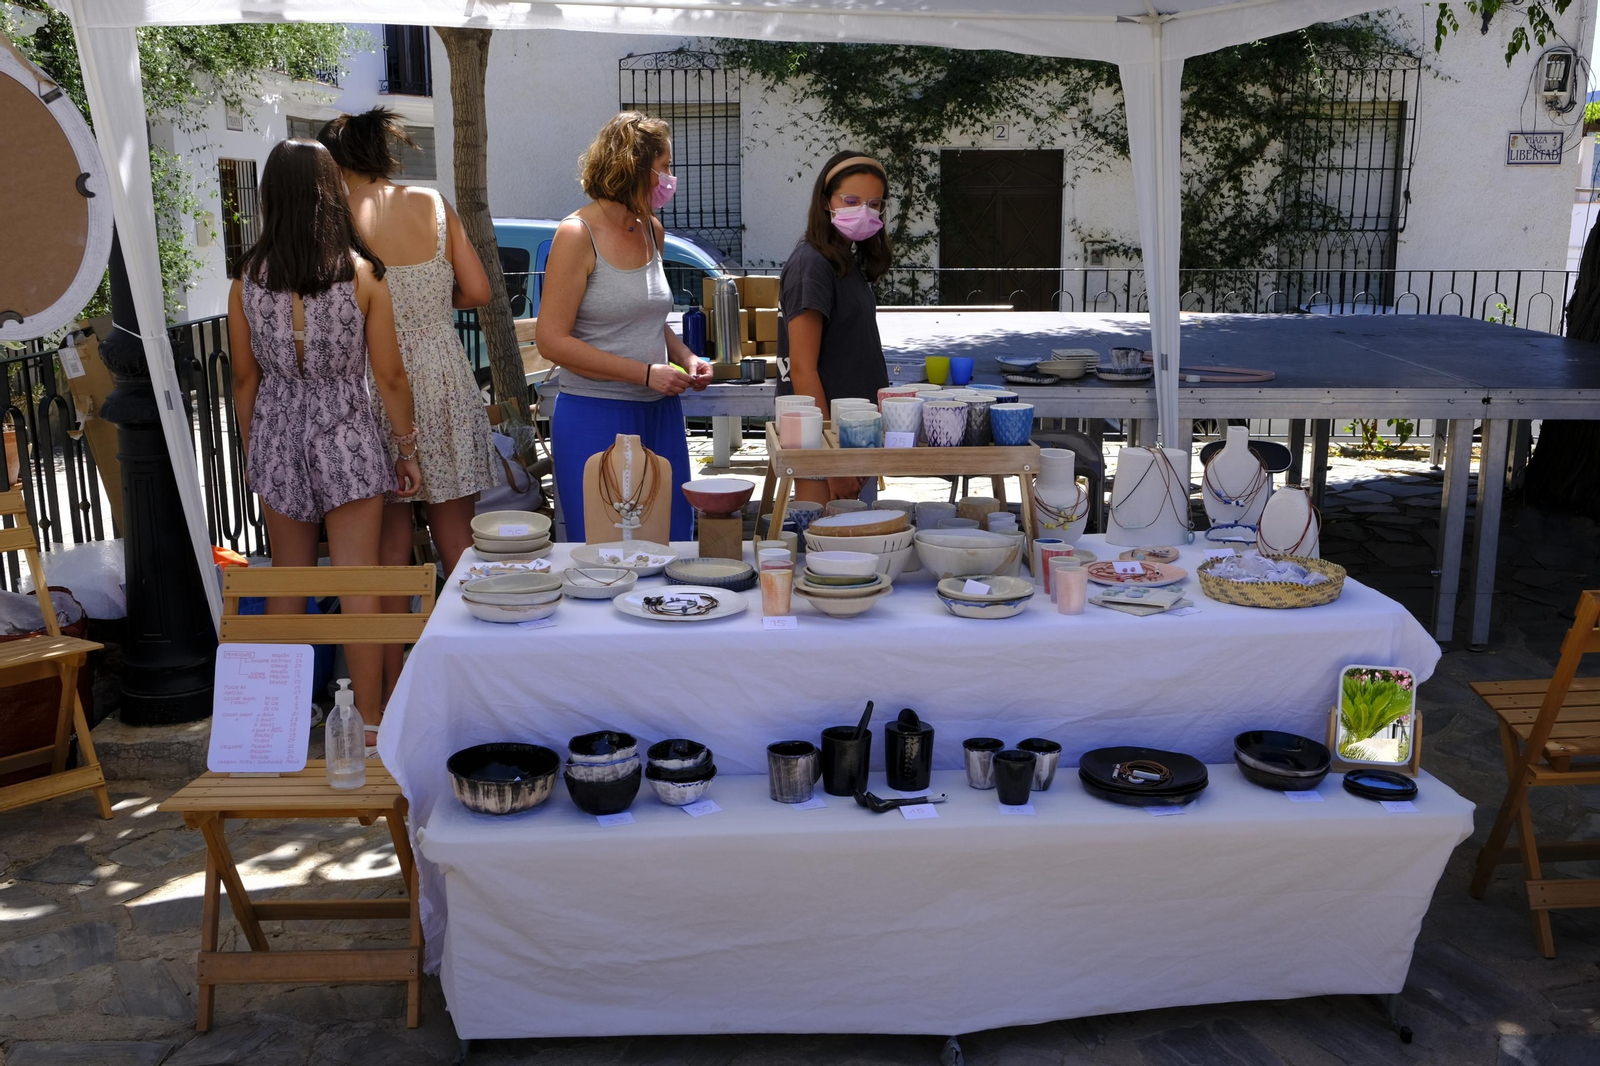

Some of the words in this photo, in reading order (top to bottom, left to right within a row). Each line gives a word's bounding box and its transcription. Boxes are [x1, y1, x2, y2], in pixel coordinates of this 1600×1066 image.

[996, 125, 1006, 139] 2
[1525, 136, 1548, 144] PLAZA
[1510, 149, 1560, 161] LIBERTAD
[891, 436, 907, 448] 25
[770, 619, 787, 628] 15
